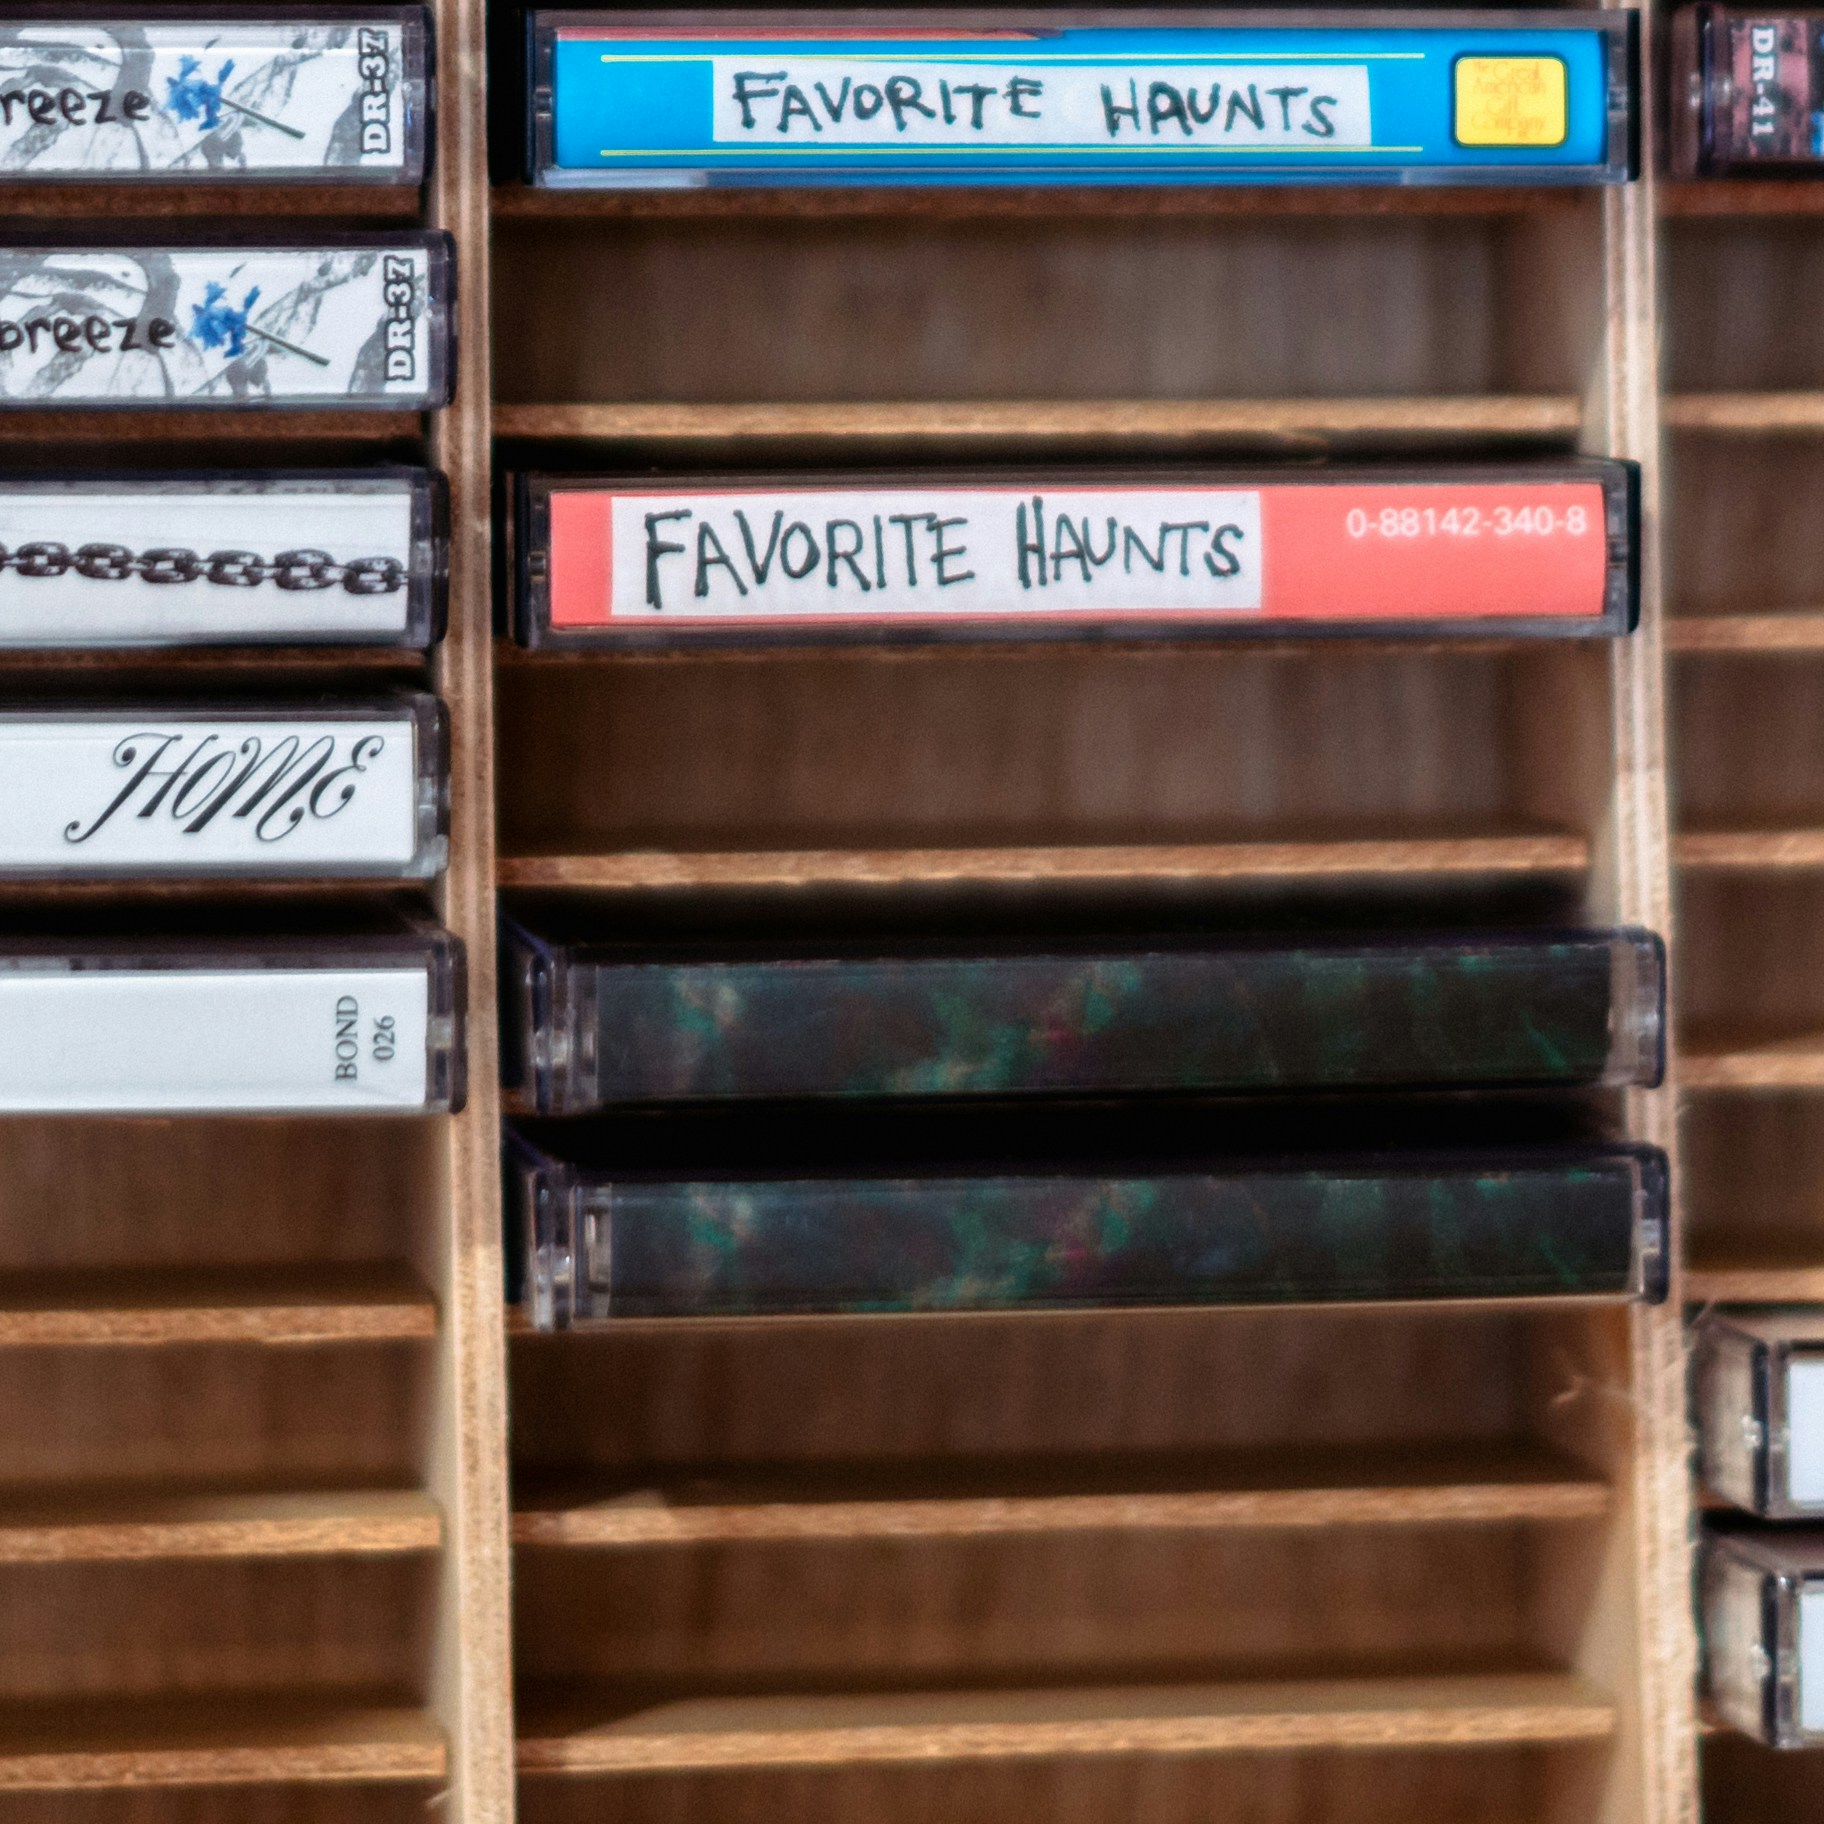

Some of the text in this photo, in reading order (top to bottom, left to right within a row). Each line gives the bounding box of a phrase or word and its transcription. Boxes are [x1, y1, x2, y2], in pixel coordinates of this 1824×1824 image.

[357, 26, 392, 154] DR-37
[732, 70, 1339, 138] FAVORITE HAUNTS
[1751, 26, 1776, 136] DR-41
[382, 254, 416, 382] DR-37
[643, 496, 1247, 609] FAVORITE HAUNTS
[1345, 505, 1589, 540] 0-88142-340-8
[64, 731, 385, 844] HOME
[334, 995, 359, 1081] BOND
[372, 1015, 396, 1061] 026
